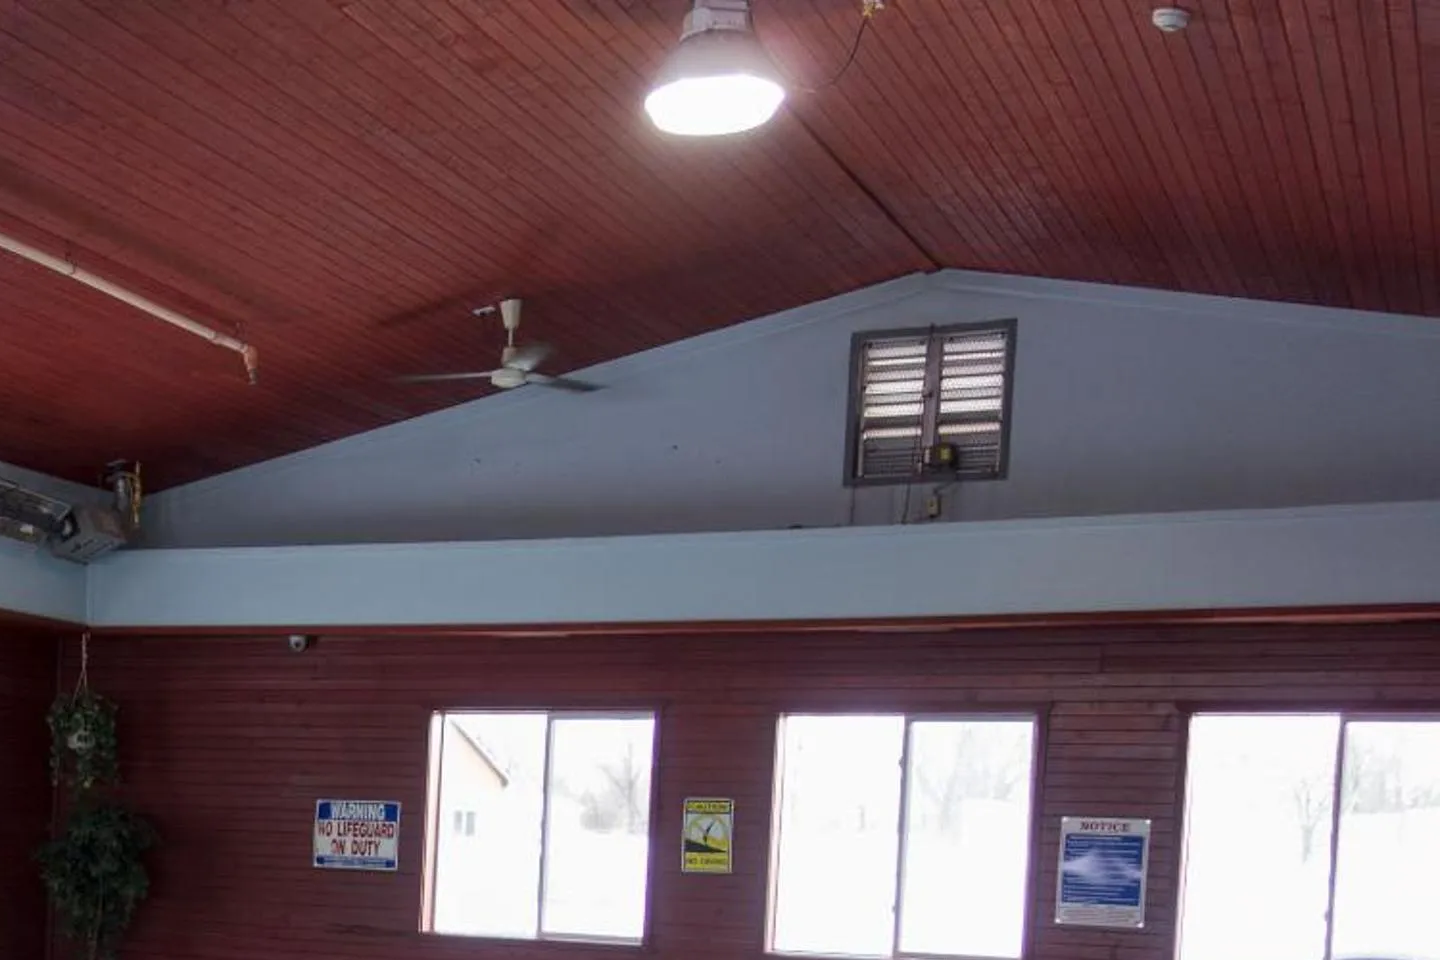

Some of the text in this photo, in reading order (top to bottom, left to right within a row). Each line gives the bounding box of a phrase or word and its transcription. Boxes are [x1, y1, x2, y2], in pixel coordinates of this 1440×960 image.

[330, 802, 386, 821] WARNING
[318, 821, 394, 839] NO LIFEGUARD
[1080, 821, 1130, 833] NOTICE
[331, 838, 382, 856] ON DUTY
